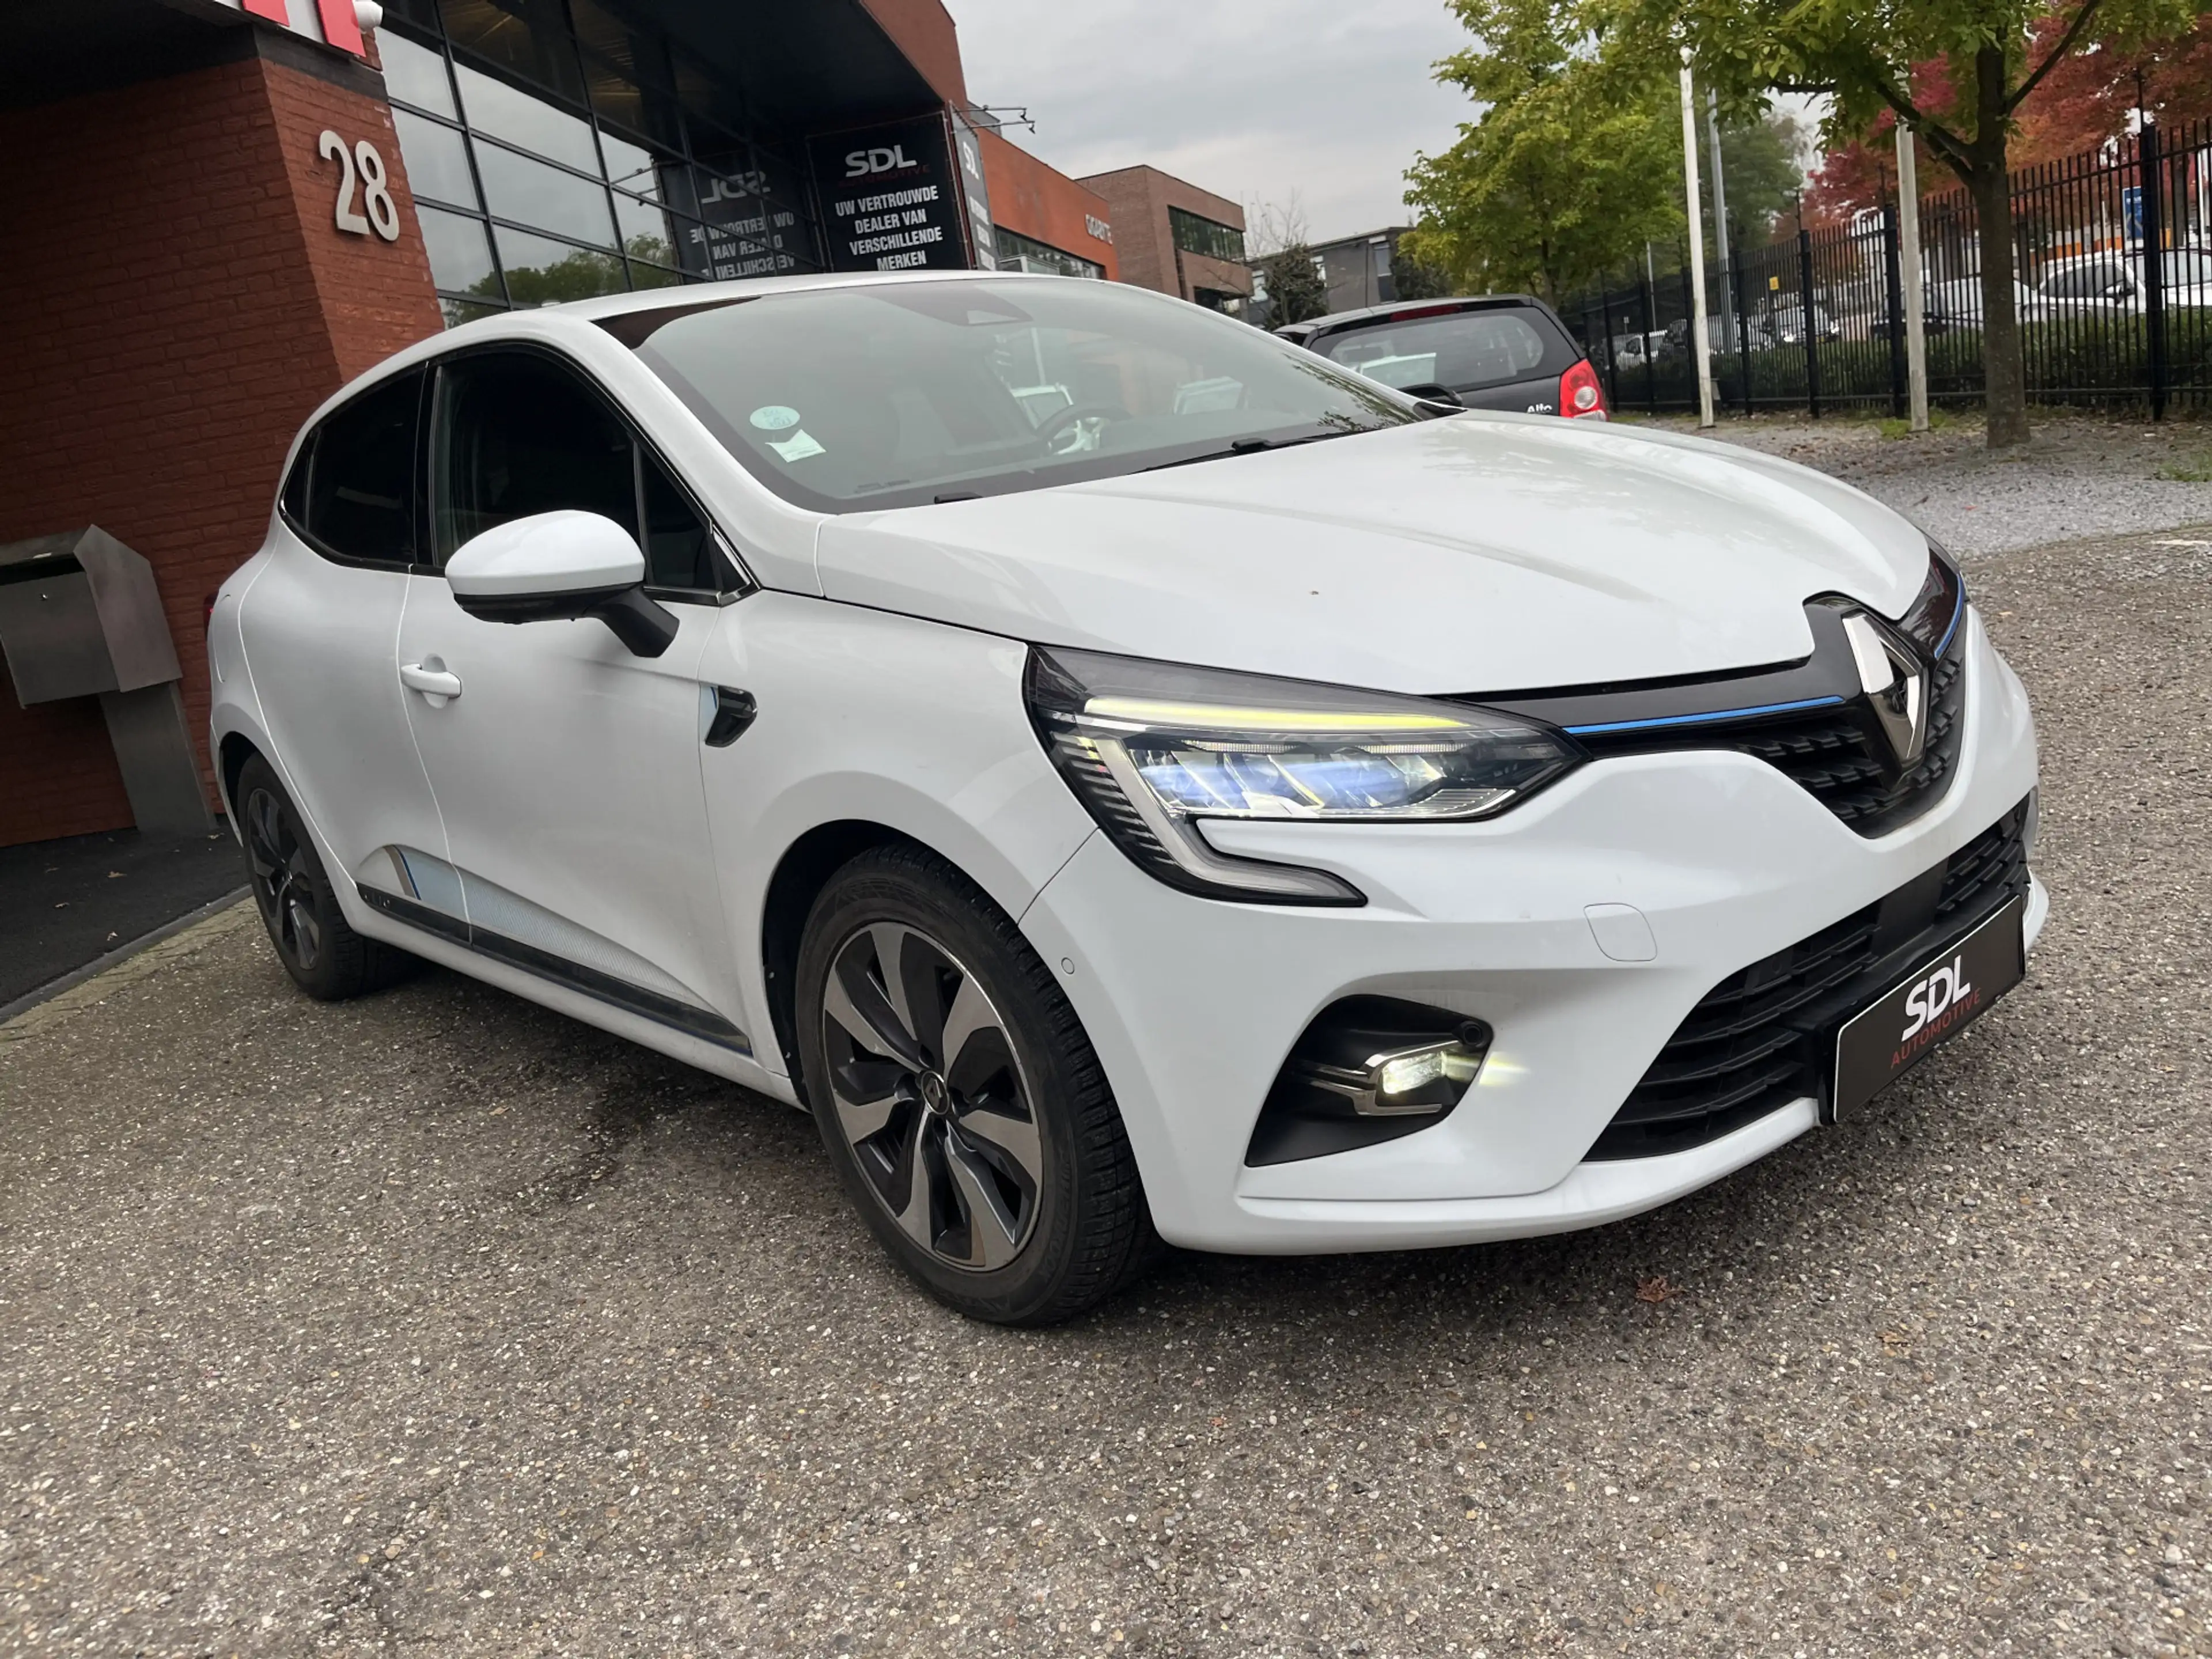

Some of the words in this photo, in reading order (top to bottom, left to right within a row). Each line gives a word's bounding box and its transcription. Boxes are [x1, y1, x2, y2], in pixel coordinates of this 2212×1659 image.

[845, 145, 918, 177] SDL
[319, 130, 399, 241] 28
[835, 200, 855, 217] UW
[858, 185, 939, 213] VERTROUWDE
[854, 213, 900, 234] DEALER
[902, 209, 927, 226] VAN
[849, 226, 943, 255] VERSCHILLENDE
[876, 250, 927, 271] MERKEN
[1902, 955, 1971, 1042] SDL
[1891, 987, 1982, 1071] AUTOMOTIVE
